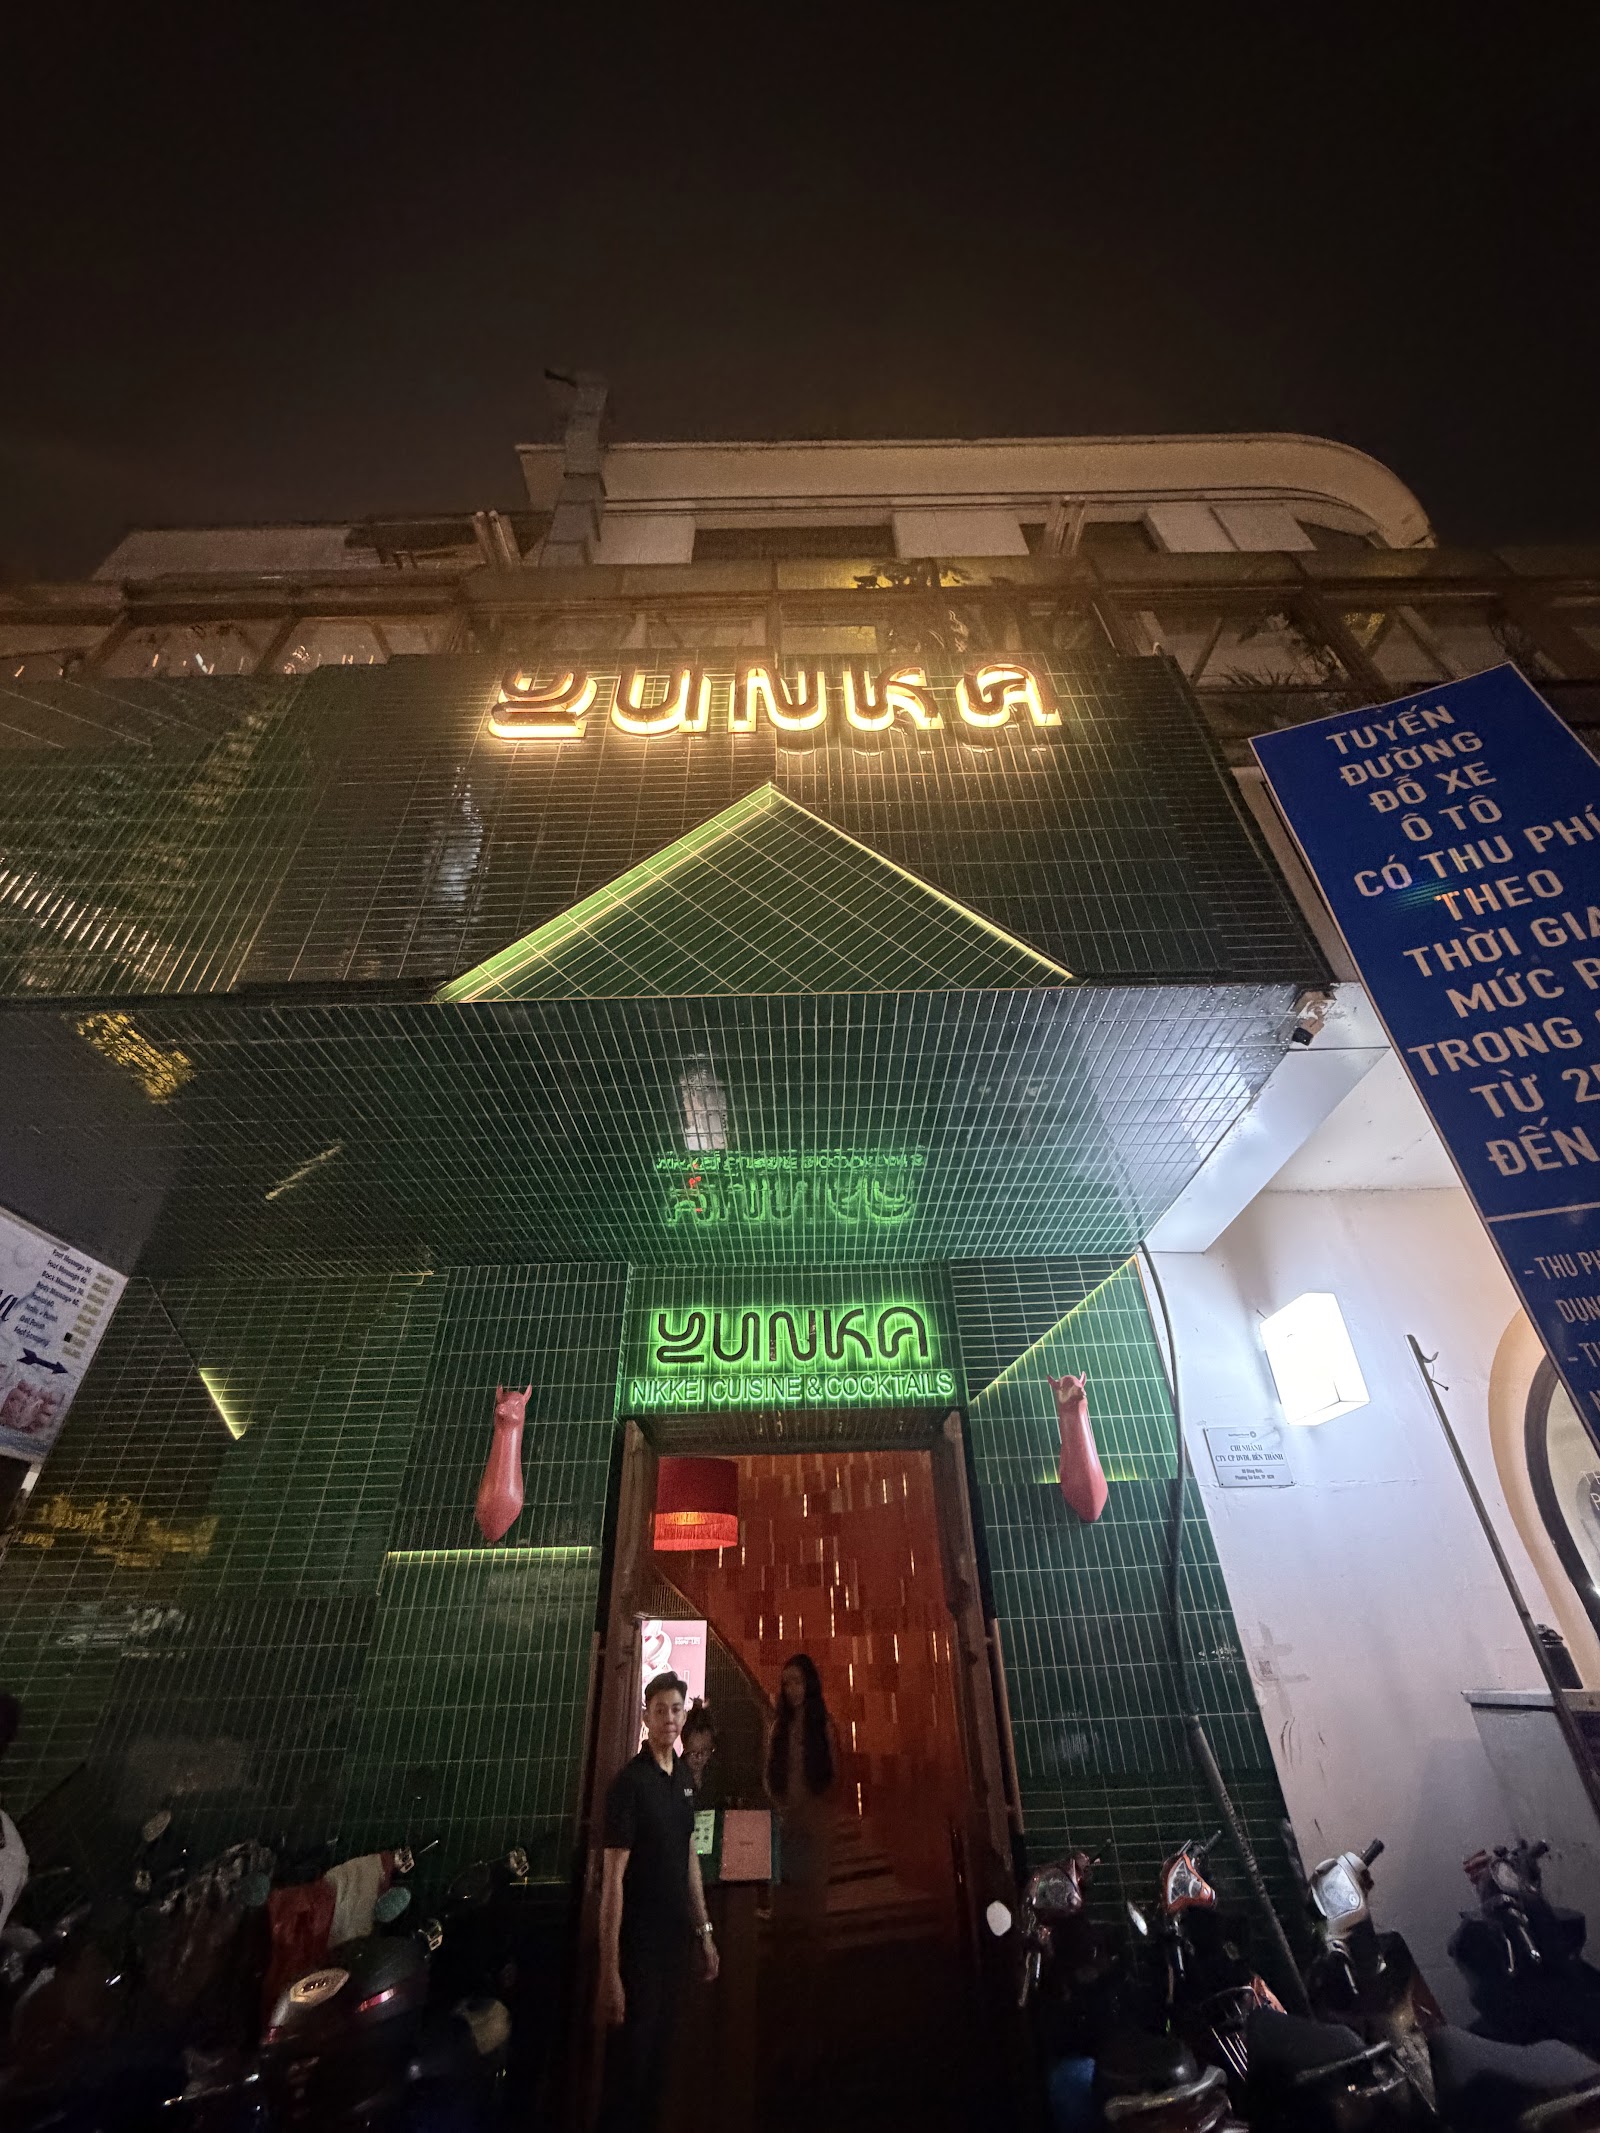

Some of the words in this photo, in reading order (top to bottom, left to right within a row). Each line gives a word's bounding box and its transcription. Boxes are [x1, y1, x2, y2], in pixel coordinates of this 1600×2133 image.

[488, 664, 1062, 739] YUNKA
[1326, 704, 1455, 755] TUYẾN
[1340, 731, 1484, 787] ĐƯỜNG
[1369, 775, 1428, 814] ĐỖ
[1436, 760, 1497, 795] XE
[1401, 813, 1433, 842] Ô
[1439, 794, 1503, 832] TÔ
[1354, 854, 1414, 897] CÓ
[1419, 835, 1514, 879] THU
[1434, 869, 1564, 921] THEO
[1403, 926, 1522, 977] THỜI
[1446, 967, 1565, 1019] MỨC
[1407, 1016, 1583, 1076] TRONG
[1470, 1069, 1544, 1119] TỪ
[1486, 1116, 1600, 1177] ĐẾN
[655, 1305, 929, 1364] YUNKA
[631, 1377, 704, 1404] NIKKEI
[711, 1374, 802, 1401] CUISINE
[807, 1375, 822, 1399] &
[825, 1371, 955, 1398] COCKTAILS
